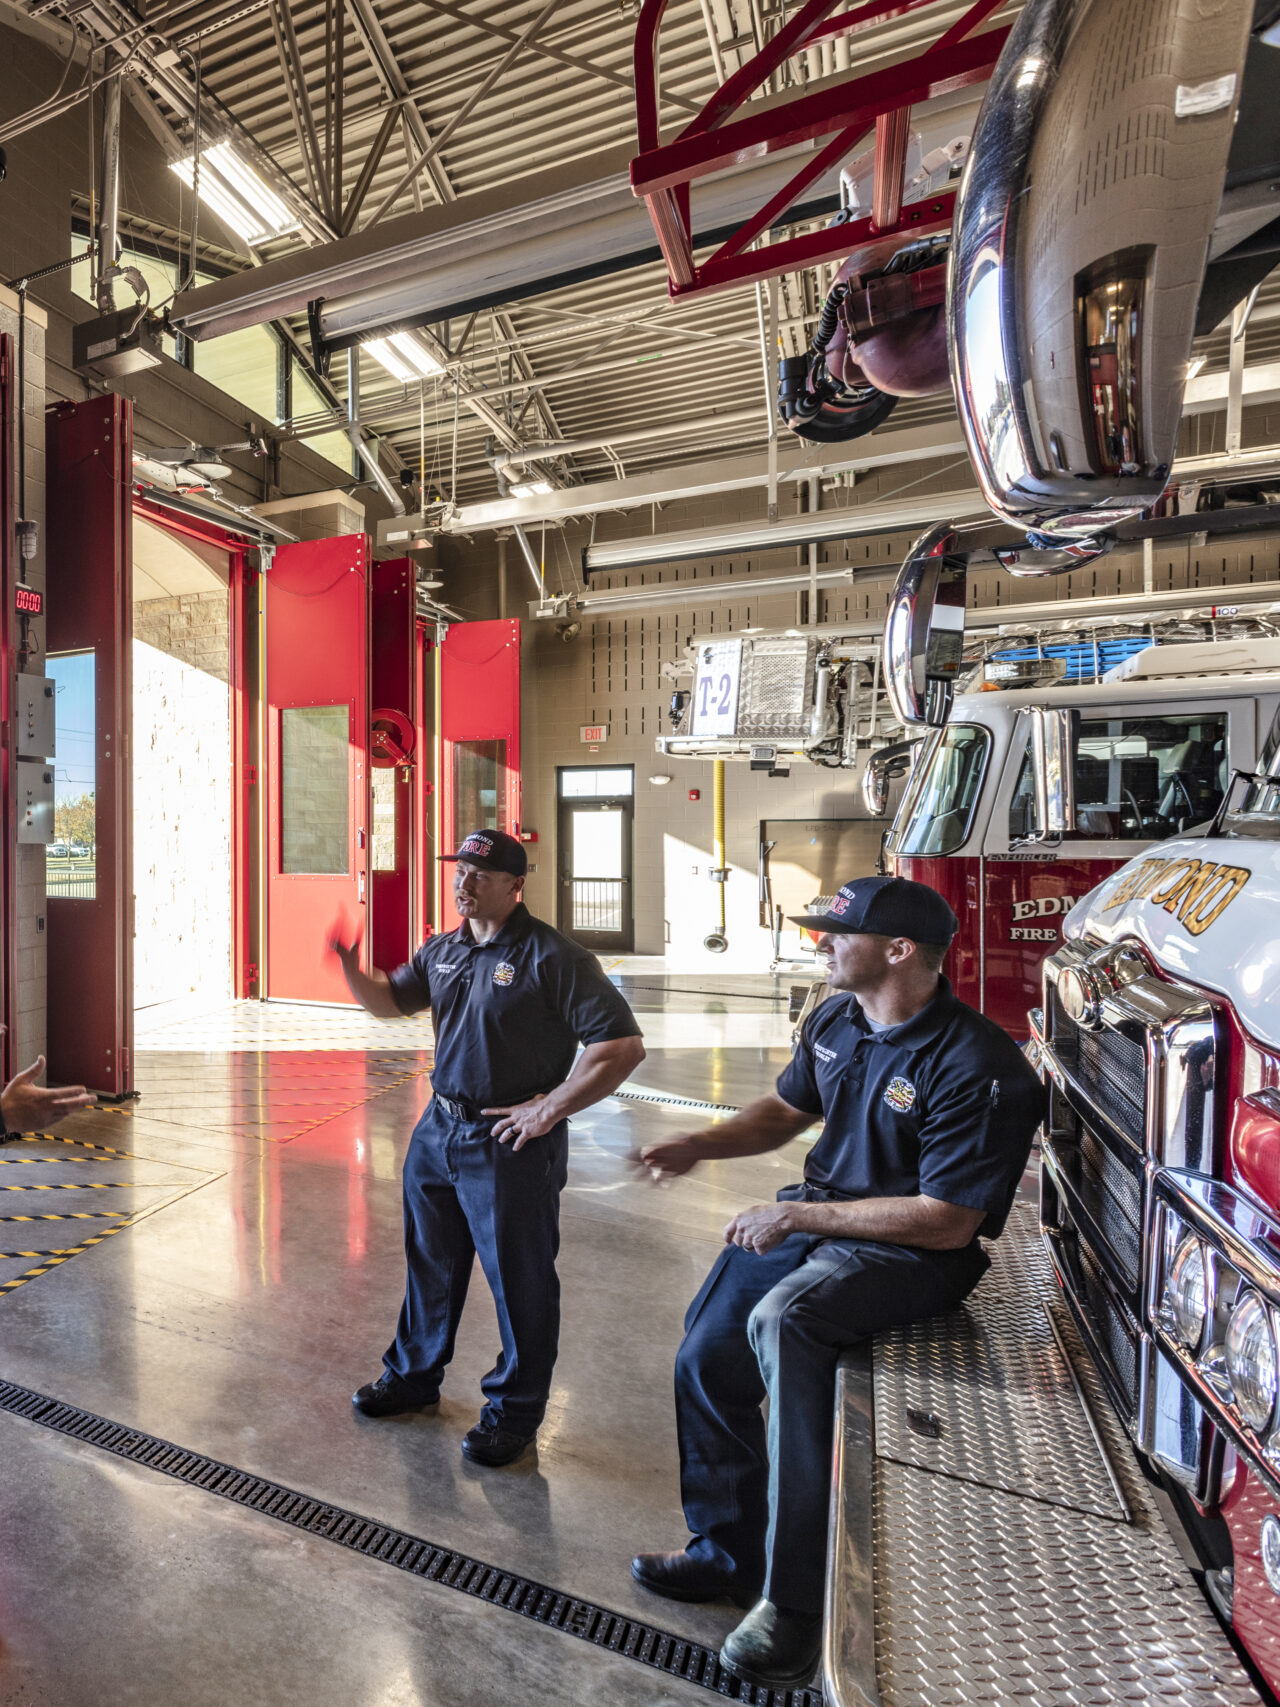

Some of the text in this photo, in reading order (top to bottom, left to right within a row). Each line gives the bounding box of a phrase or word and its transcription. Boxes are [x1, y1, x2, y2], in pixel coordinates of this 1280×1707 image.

[699, 673, 731, 716] T-2
[585, 727, 602, 740] EXIT
[1010, 928, 1057, 941] FIRE
